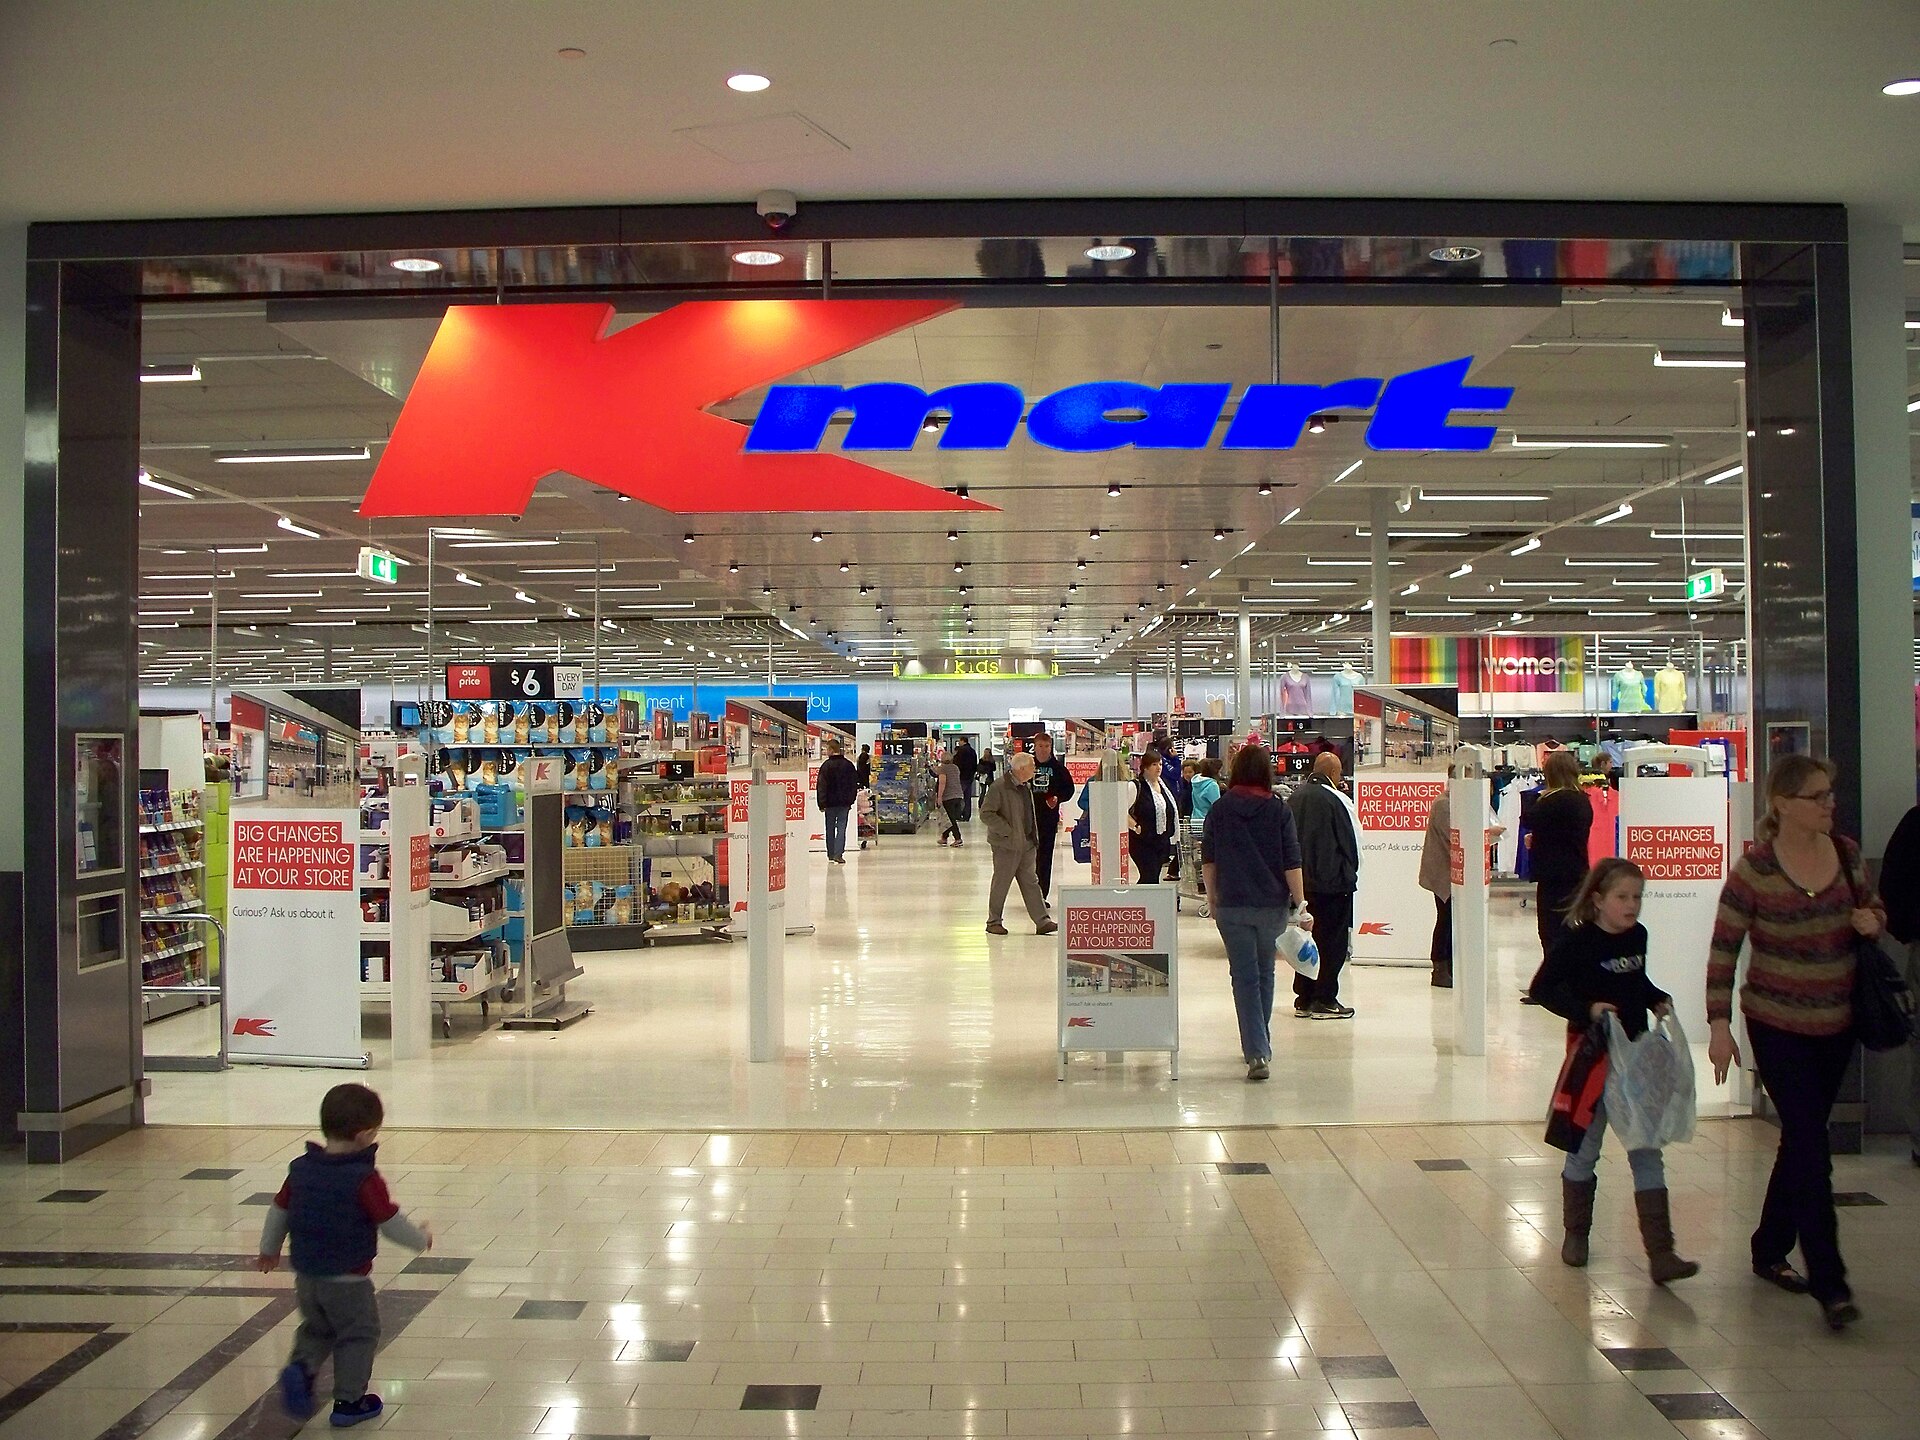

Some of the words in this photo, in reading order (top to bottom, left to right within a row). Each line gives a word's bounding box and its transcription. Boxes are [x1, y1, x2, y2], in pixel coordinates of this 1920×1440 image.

[954, 659, 999, 674] kids
[1484, 656, 1579, 675] womens
[461, 669, 477, 677] our
[556, 673, 581, 682] EVERY
[458, 676, 481, 688] price
[510, 669, 541, 696] $6
[562, 682, 577, 691] DAY
[885, 744, 904, 755] $15
[733, 782, 749, 793] BIG
[1361, 785, 1383, 797] BIG
[1385, 785, 1442, 797] CHANGES
[1361, 800, 1382, 812] ARE
[1385, 800, 1431, 812] HAPPENI
[733, 809, 744, 820] AT
[785, 807, 803, 818] ORE
[1361, 815, 1376, 828] AT
[1377, 815, 1411, 828] YOUR
[238, 825, 264, 841] BIG
[267, 826, 338, 843] CHANGES
[1630, 829, 1653, 842] BIG
[1656, 829, 1712, 842] CHANGES
[1361, 842, 1387, 851] urious?
[1388, 843, 1400, 851] Ask
[237, 846, 264, 863] ARE
[267, 847, 351, 865] HAPPENING
[1630, 846, 1653, 860] ARE
[1656, 846, 1721, 860] HAPPENING
[236, 867, 253, 884] AT
[256, 868, 299, 885] YOUR
[304, 869, 350, 886] STORE
[1648, 864, 1682, 877] YOUR
[1685, 864, 1720, 877] STORE
[232, 906, 268, 918] Curious?
[270, 907, 285, 918] Ask
[287, 910, 297, 918] us
[299, 908, 326, 919] about
[328, 909, 336, 920] it.
[1070, 910, 1089, 921] BIG
[1092, 910, 1144, 921] CHANGES
[1069, 923, 1089, 934] ARE
[1092, 923, 1152, 934] HAPPENING
[1069, 936, 1081, 947] AT
[1084, 936, 1115, 947] YOUR
[1118, 936, 1151, 947] STORE
